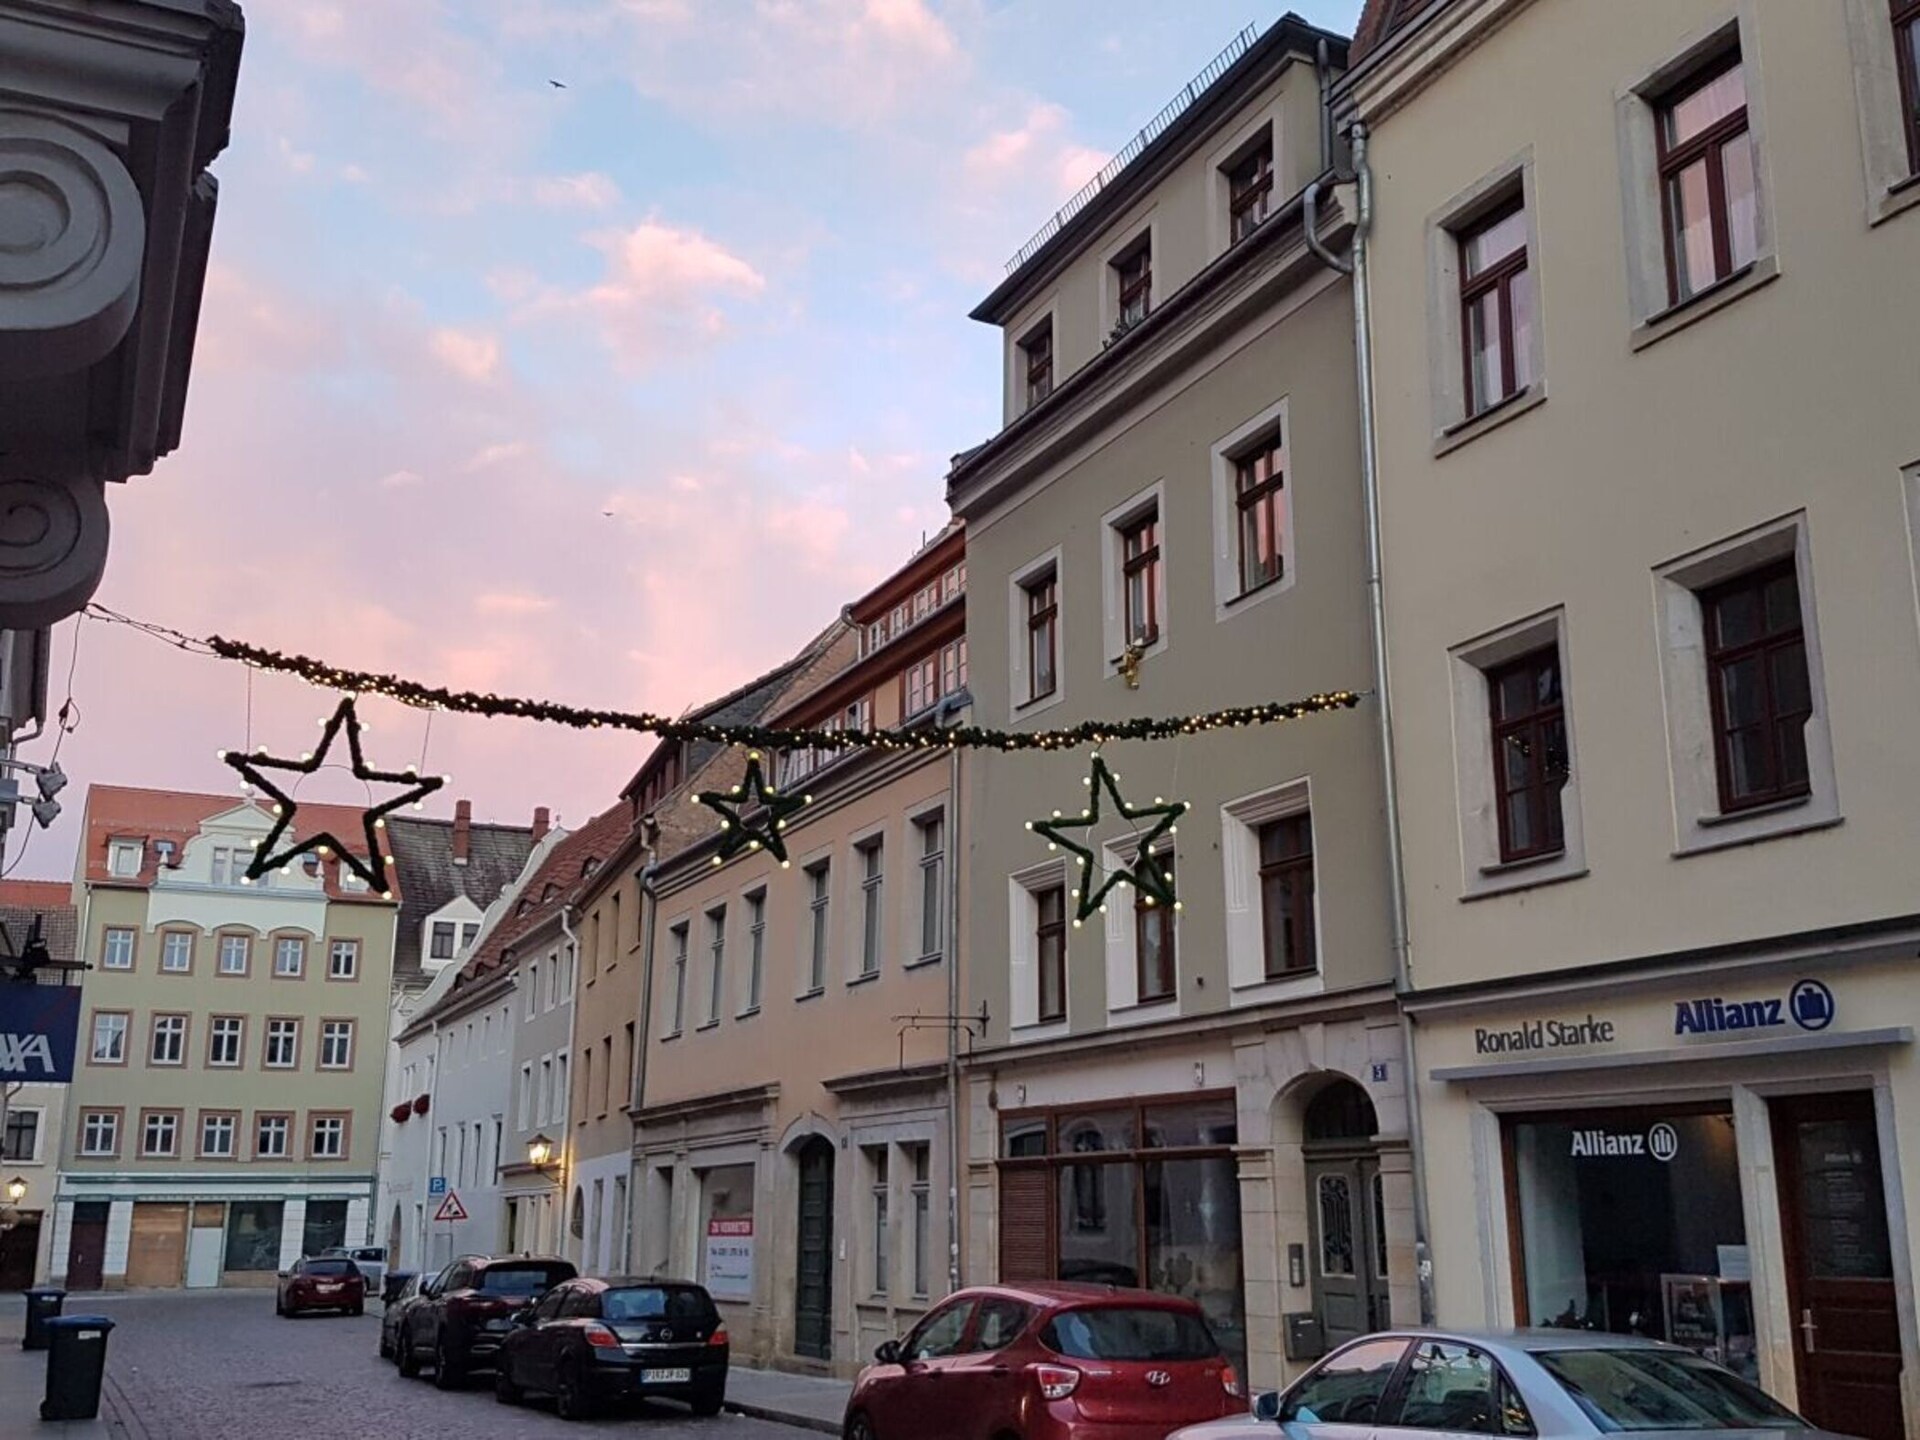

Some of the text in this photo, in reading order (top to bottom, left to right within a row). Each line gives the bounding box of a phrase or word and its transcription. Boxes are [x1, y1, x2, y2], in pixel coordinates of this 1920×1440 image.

[1475, 1014, 1614, 1054] Ronald Starke
[1675, 997, 1785, 1035] Allianz
[1571, 1130, 1645, 1157] Allianz
